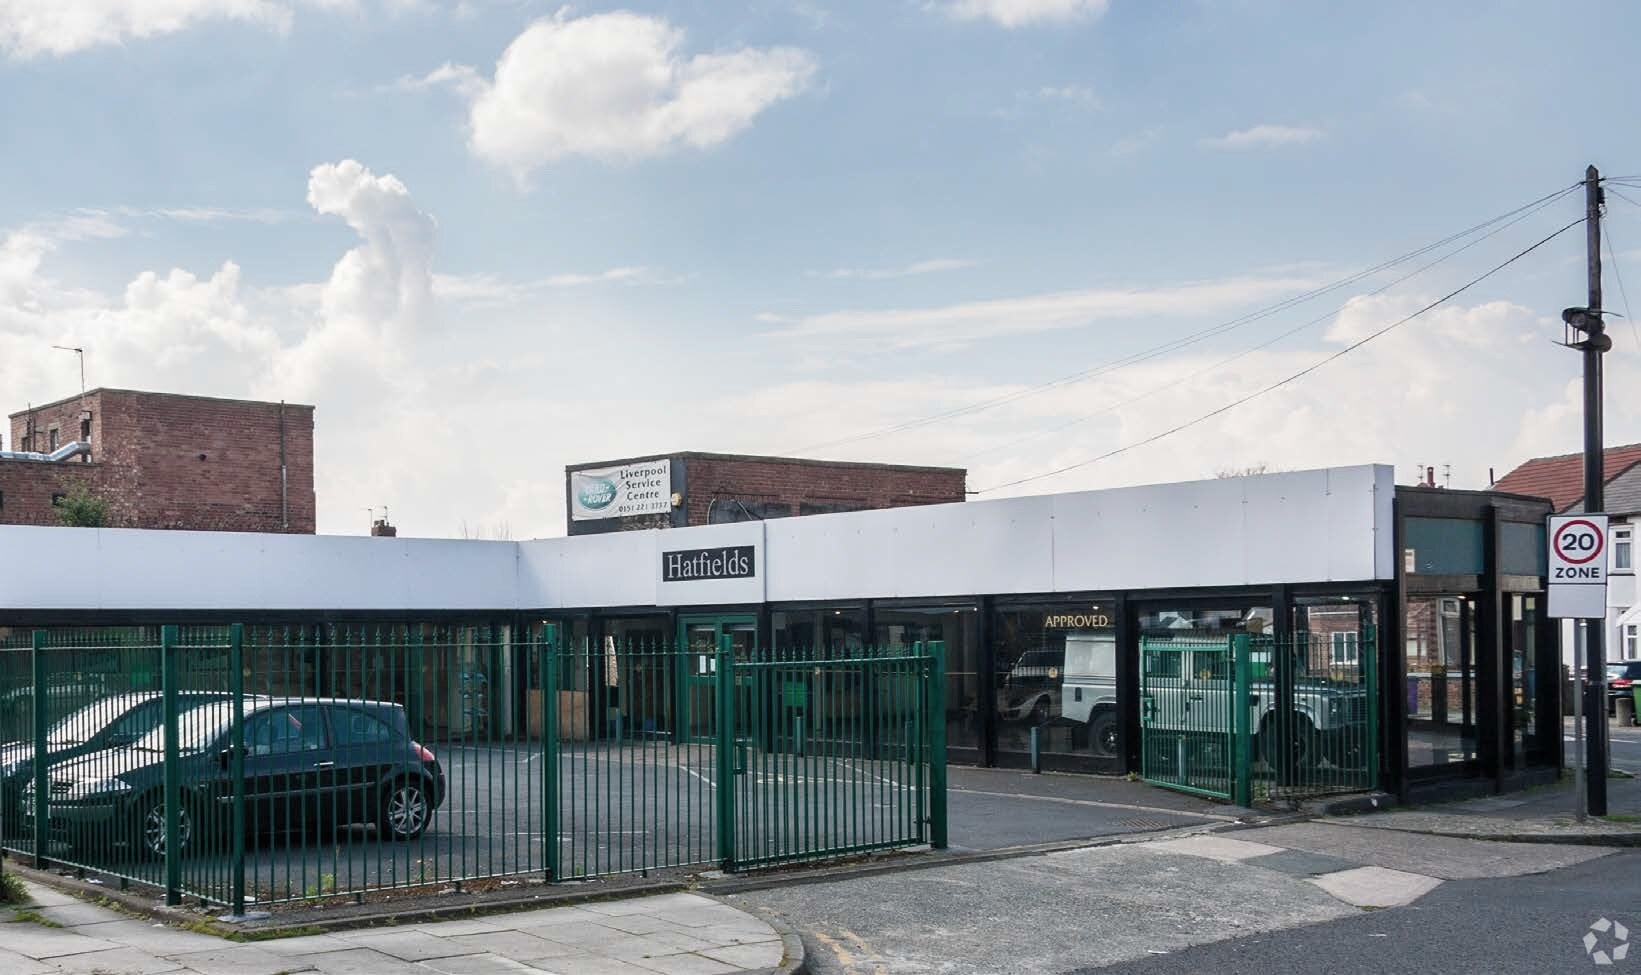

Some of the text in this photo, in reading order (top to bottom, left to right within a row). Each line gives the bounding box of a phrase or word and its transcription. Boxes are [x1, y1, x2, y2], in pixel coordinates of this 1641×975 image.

[620, 465, 666, 479] Liverpool
[625, 479, 661, 490] Service
[627, 491, 659, 501] Centre
[1562, 533, 1594, 551] 20
[667, 549, 749, 578] Hatfields
[1555, 567, 1600, 579] ZONE
[1045, 615, 1108, 627] APPROVED
